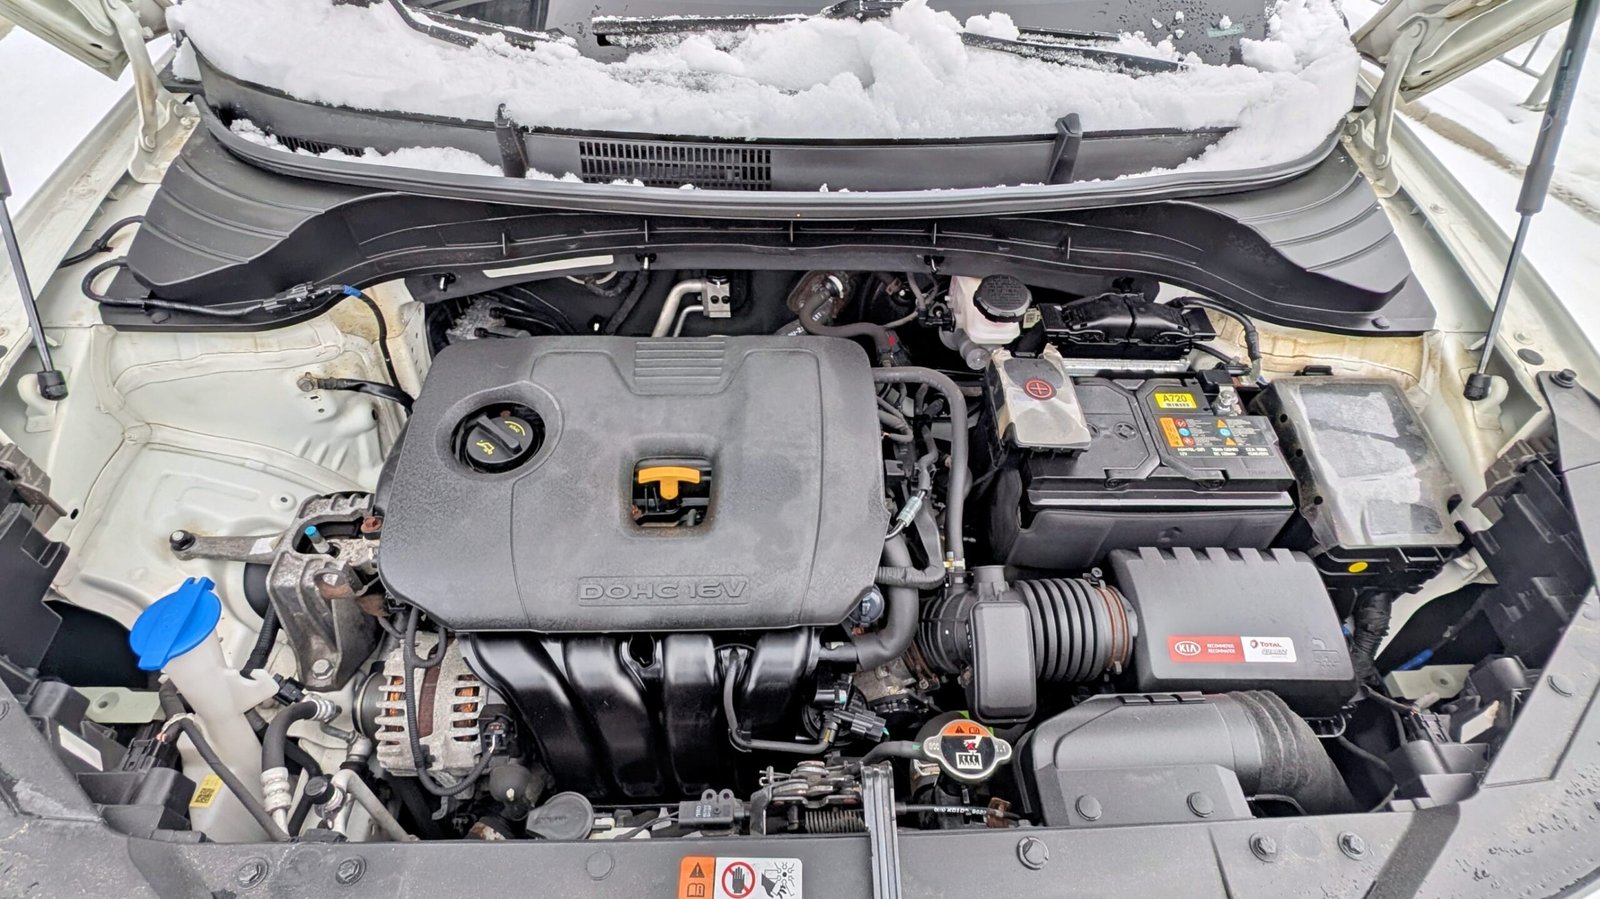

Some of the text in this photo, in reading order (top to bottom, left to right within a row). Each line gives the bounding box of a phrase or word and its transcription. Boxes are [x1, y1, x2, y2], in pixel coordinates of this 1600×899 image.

[1163, 394, 1188, 402] A720
[578, 582, 748, 600] DOHC 16V
[1179, 643, 1197, 653] KIA
